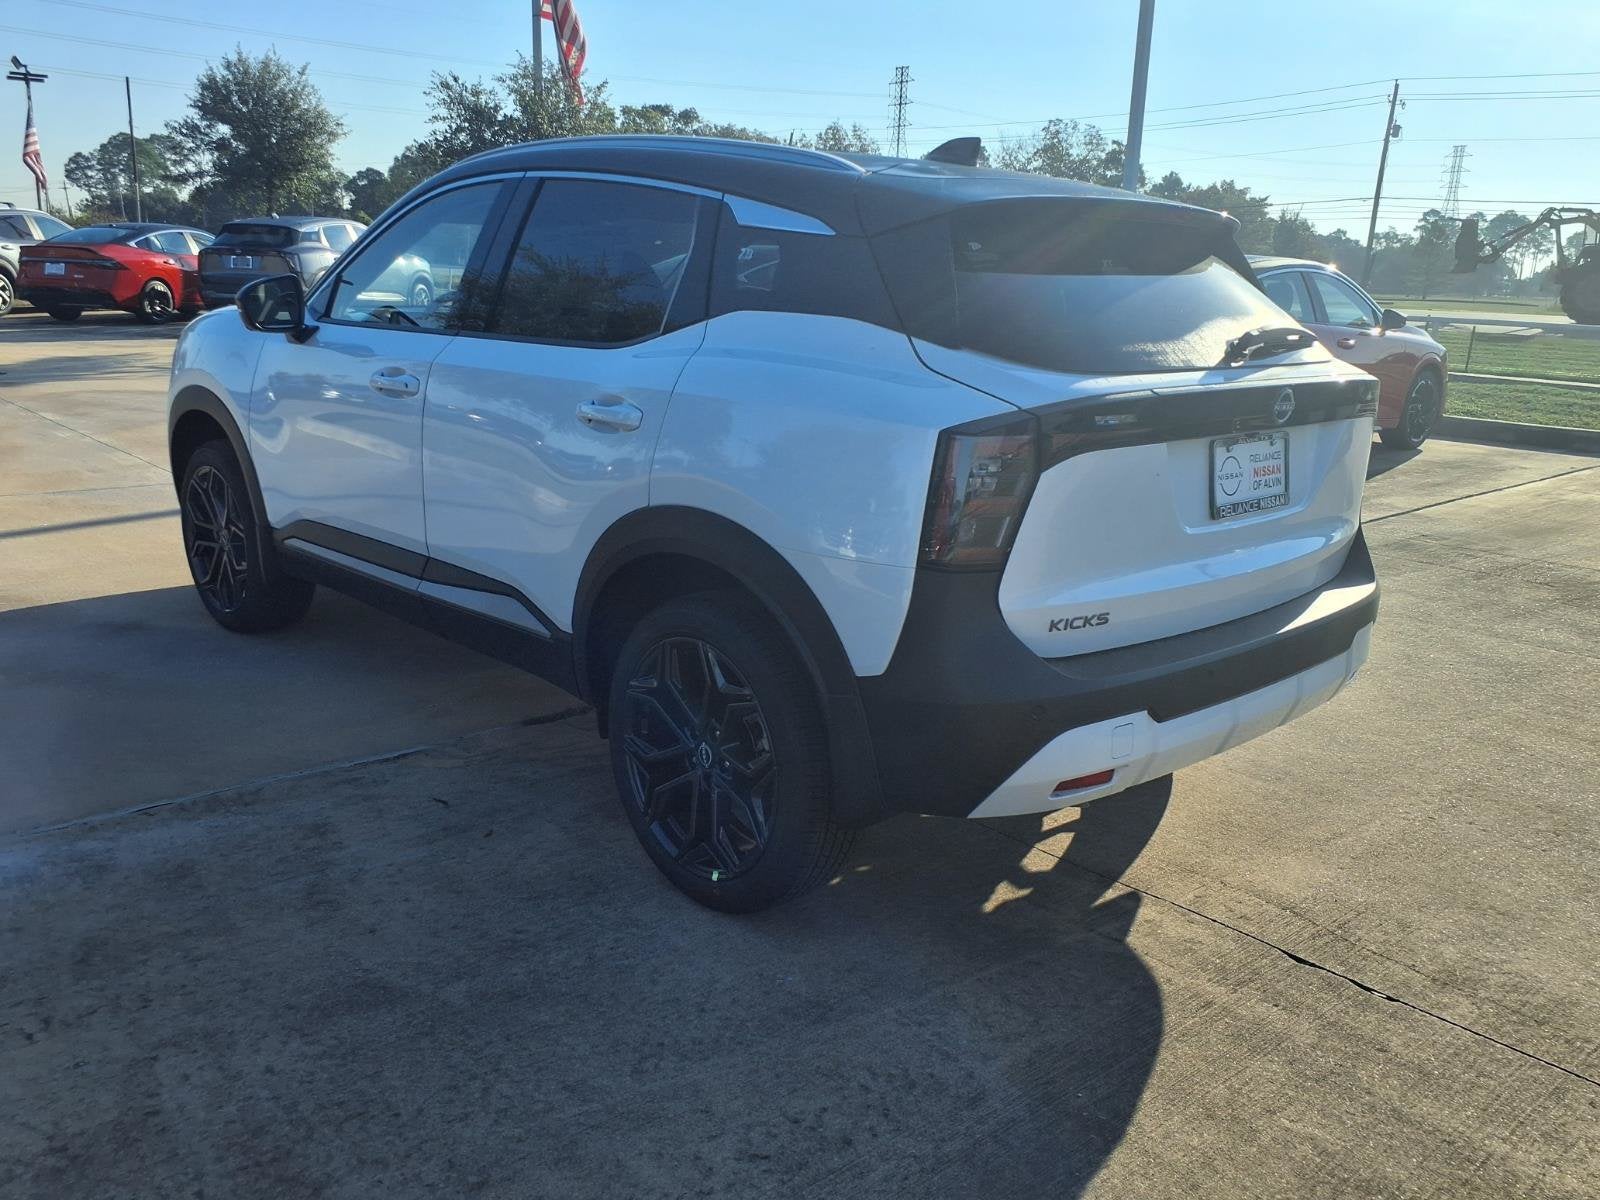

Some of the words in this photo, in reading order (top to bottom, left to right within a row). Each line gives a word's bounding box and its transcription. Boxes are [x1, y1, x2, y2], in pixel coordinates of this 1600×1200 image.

[1249, 450, 1281, 463] RELIANCE
[1217, 472, 1243, 481] NISSAN
[1253, 463, 1281, 478] NISSAN
[1252, 479, 1262, 491] OF
[1263, 477, 1282, 489] ALVIN
[1220, 502, 1258, 517] RELIANCE
[1260, 495, 1285, 509] NISSAN
[1048, 612, 1110, 632] KICKS
